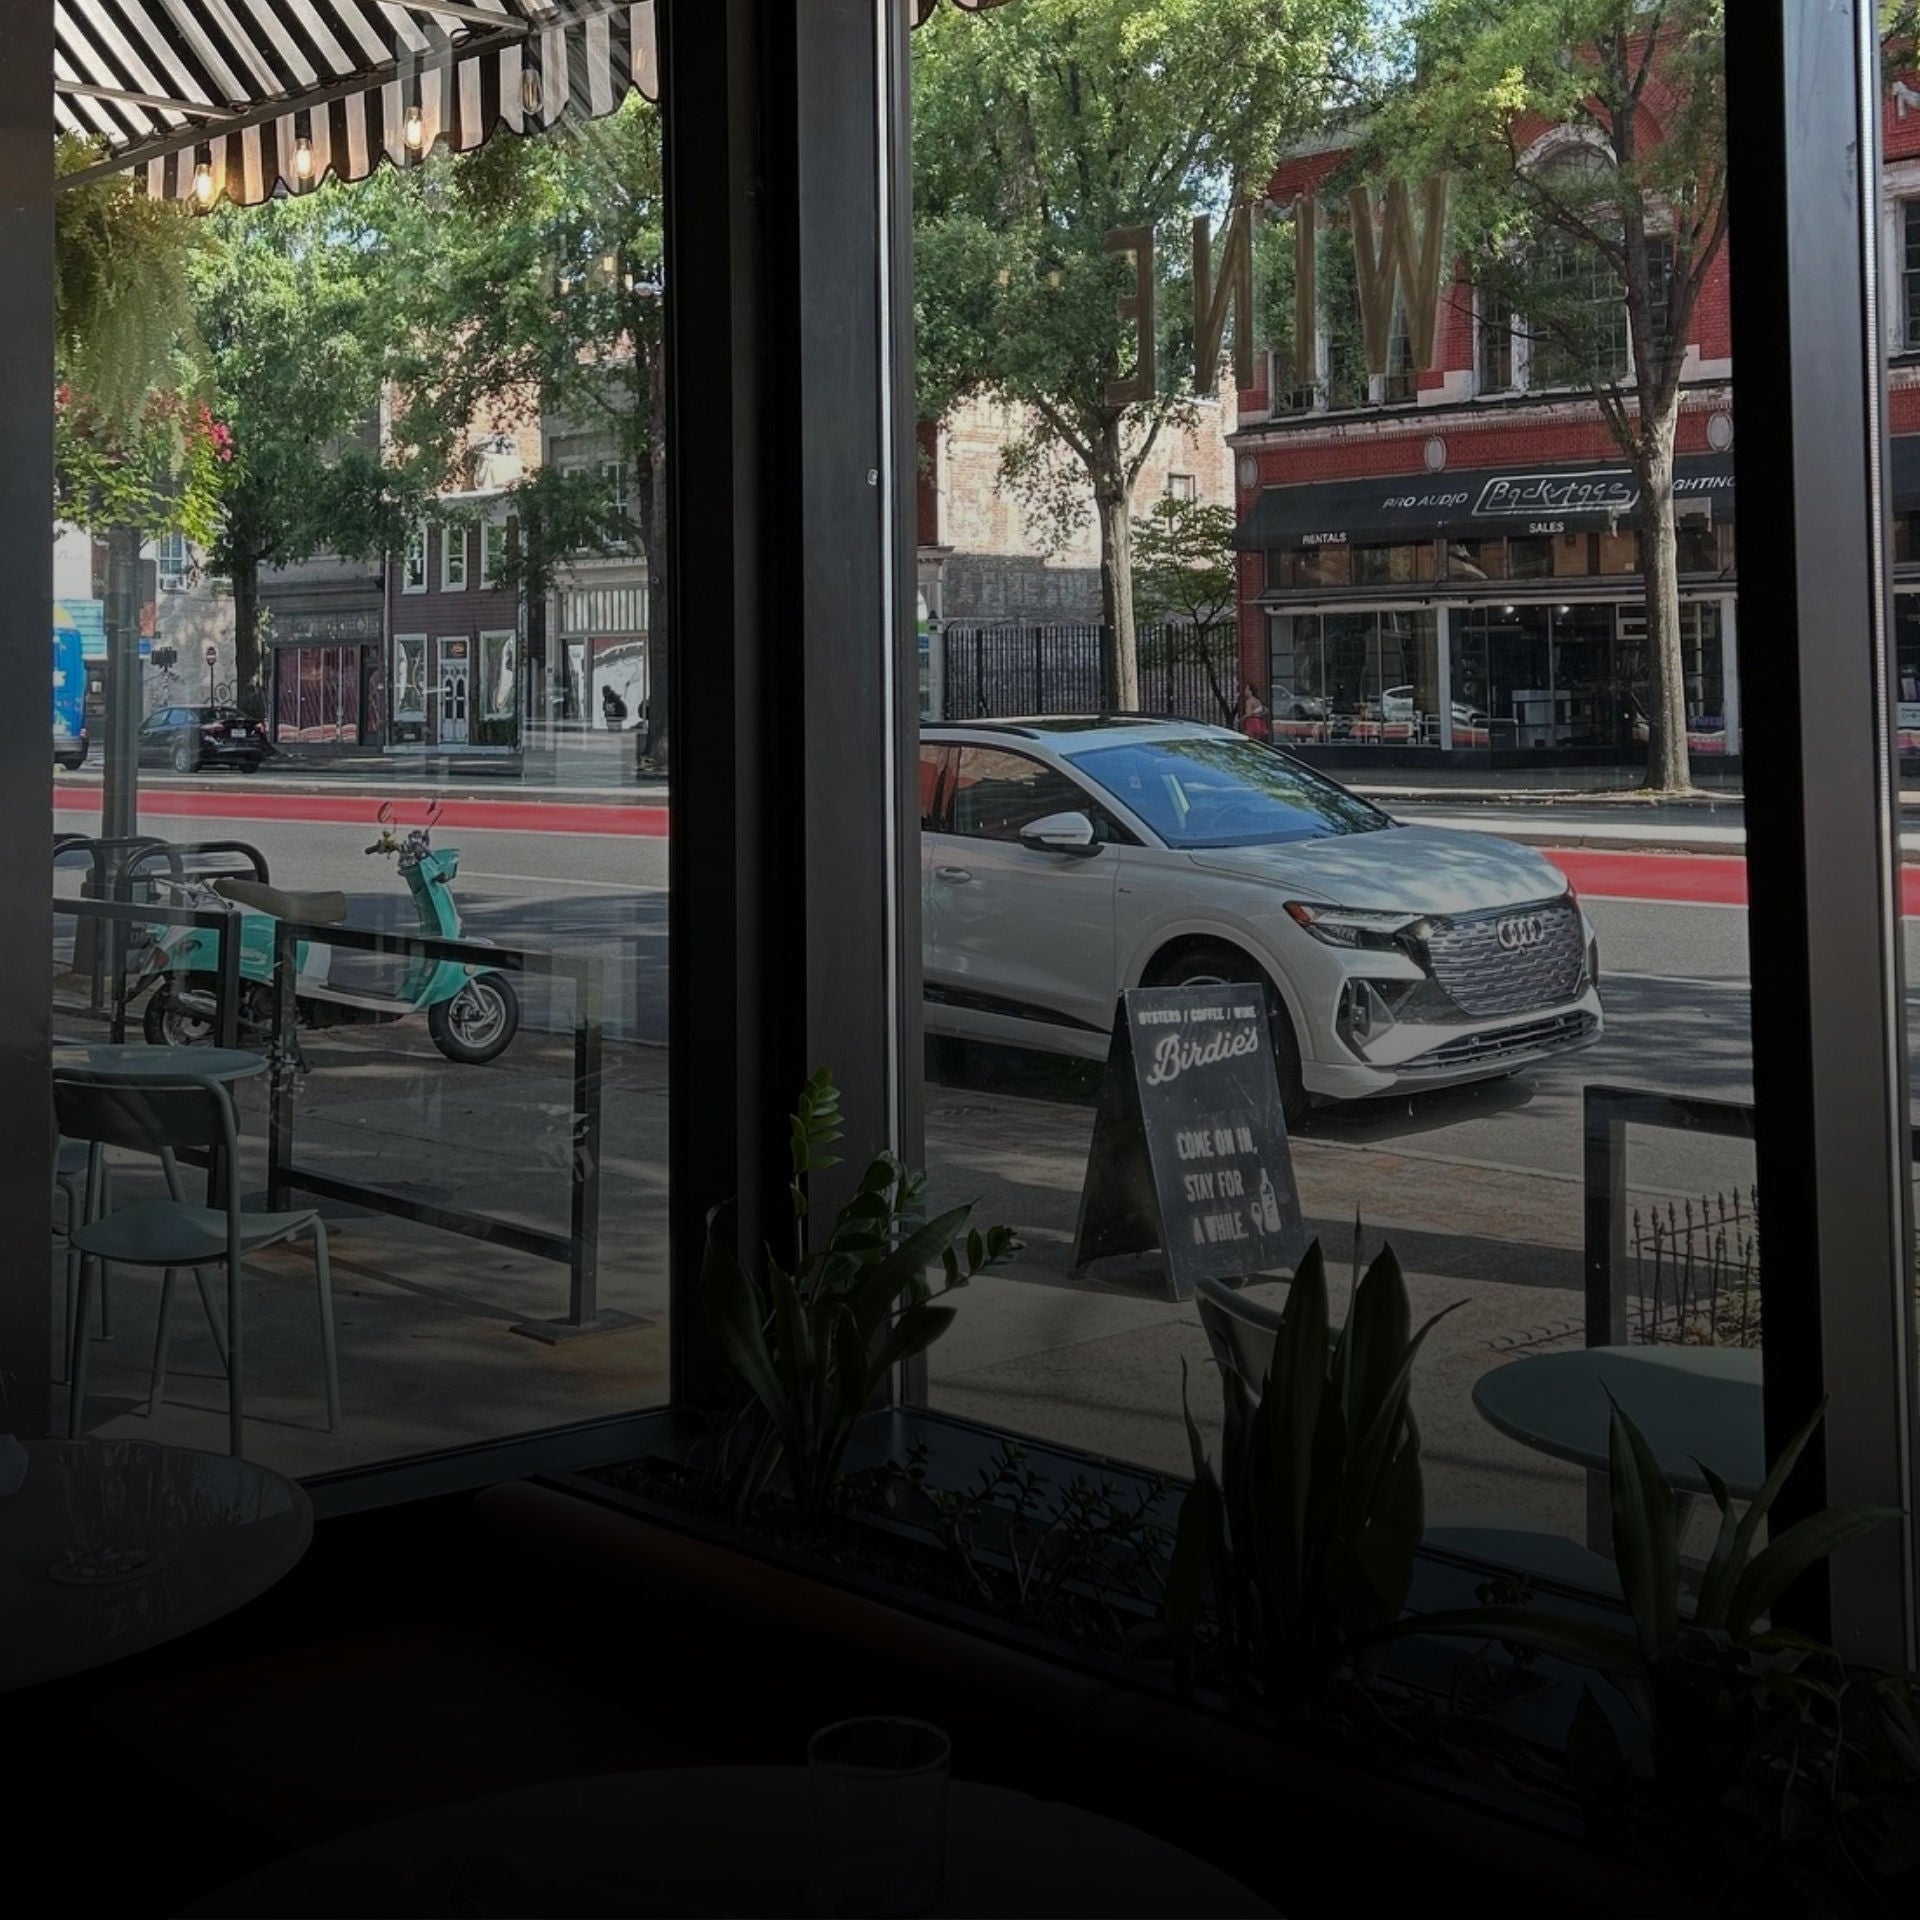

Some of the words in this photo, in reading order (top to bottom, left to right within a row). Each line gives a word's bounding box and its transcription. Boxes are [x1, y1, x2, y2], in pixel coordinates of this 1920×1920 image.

[1672, 476, 1736, 491] GHTING
[1382, 496, 1417, 510] PRO
[1417, 492, 1469, 508] AUDIO
[1529, 521, 1565, 534] SALES
[1302, 532, 1347, 545] RENTALS
[1190, 1007, 1225, 1021] COFFEE
[1233, 1005, 1257, 1018] WINE
[1146, 1026, 1258, 1086] Birdie's
[1176, 1130, 1215, 1160] COME
[1214, 1128, 1236, 1156] ON
[1184, 1172, 1215, 1203] STAY
[1217, 1170, 1245, 1198] FOR
[1192, 1217, 1206, 1245] A
